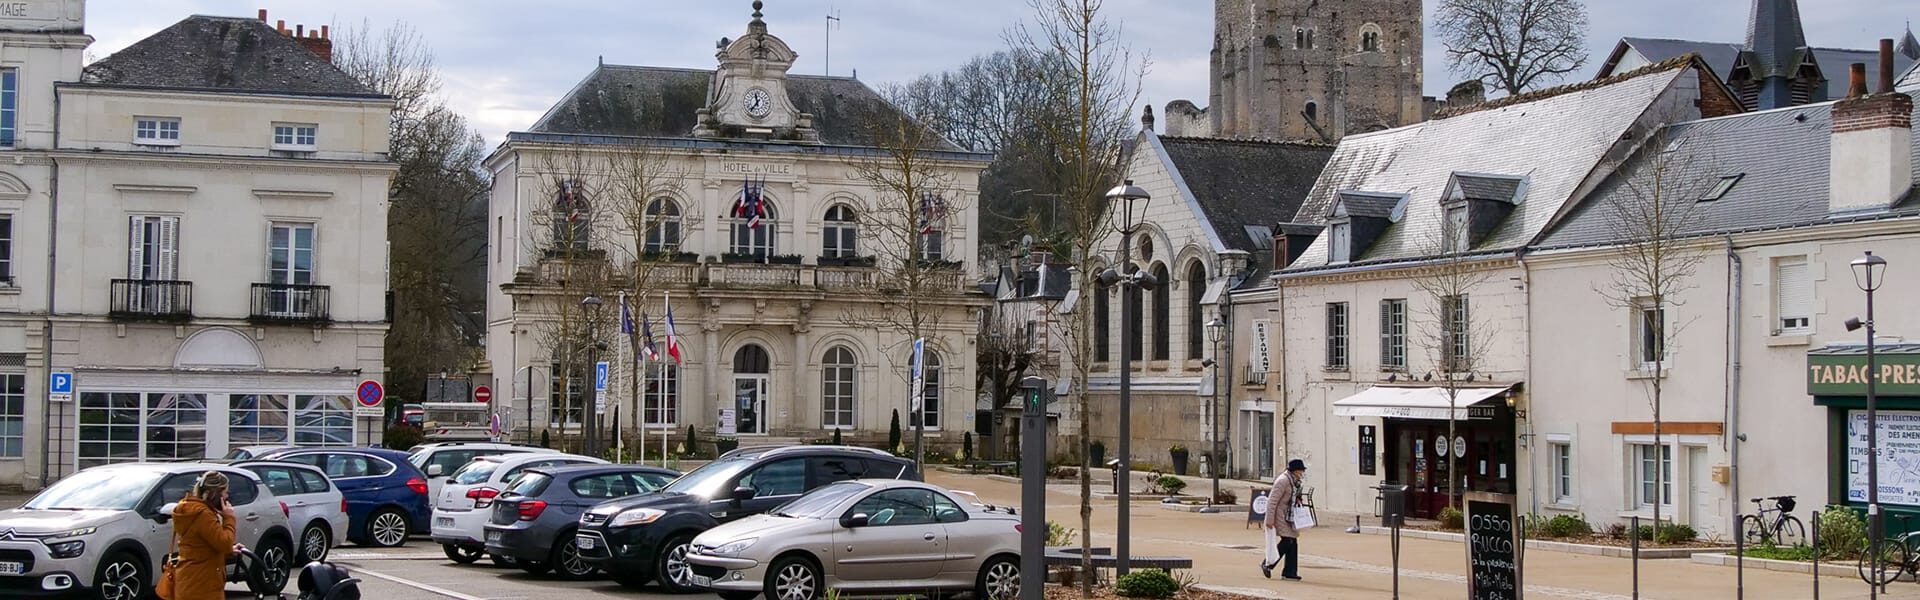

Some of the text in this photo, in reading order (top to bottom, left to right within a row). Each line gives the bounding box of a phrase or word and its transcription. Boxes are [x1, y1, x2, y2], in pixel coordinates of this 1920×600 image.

[723, 162, 753, 173] HOTEL
[763, 164, 790, 175] VILLE
[1257, 323, 1269, 371] RESTAURANT
[56, 376, 66, 390] P
[1483, 408, 1495, 417] BAR
[1888, 431, 1900, 439] DES
[1850, 446, 1882, 456] TIMBS
[1471, 514, 1511, 532] OSSO
[1471, 533, 1513, 554] BUCCO
